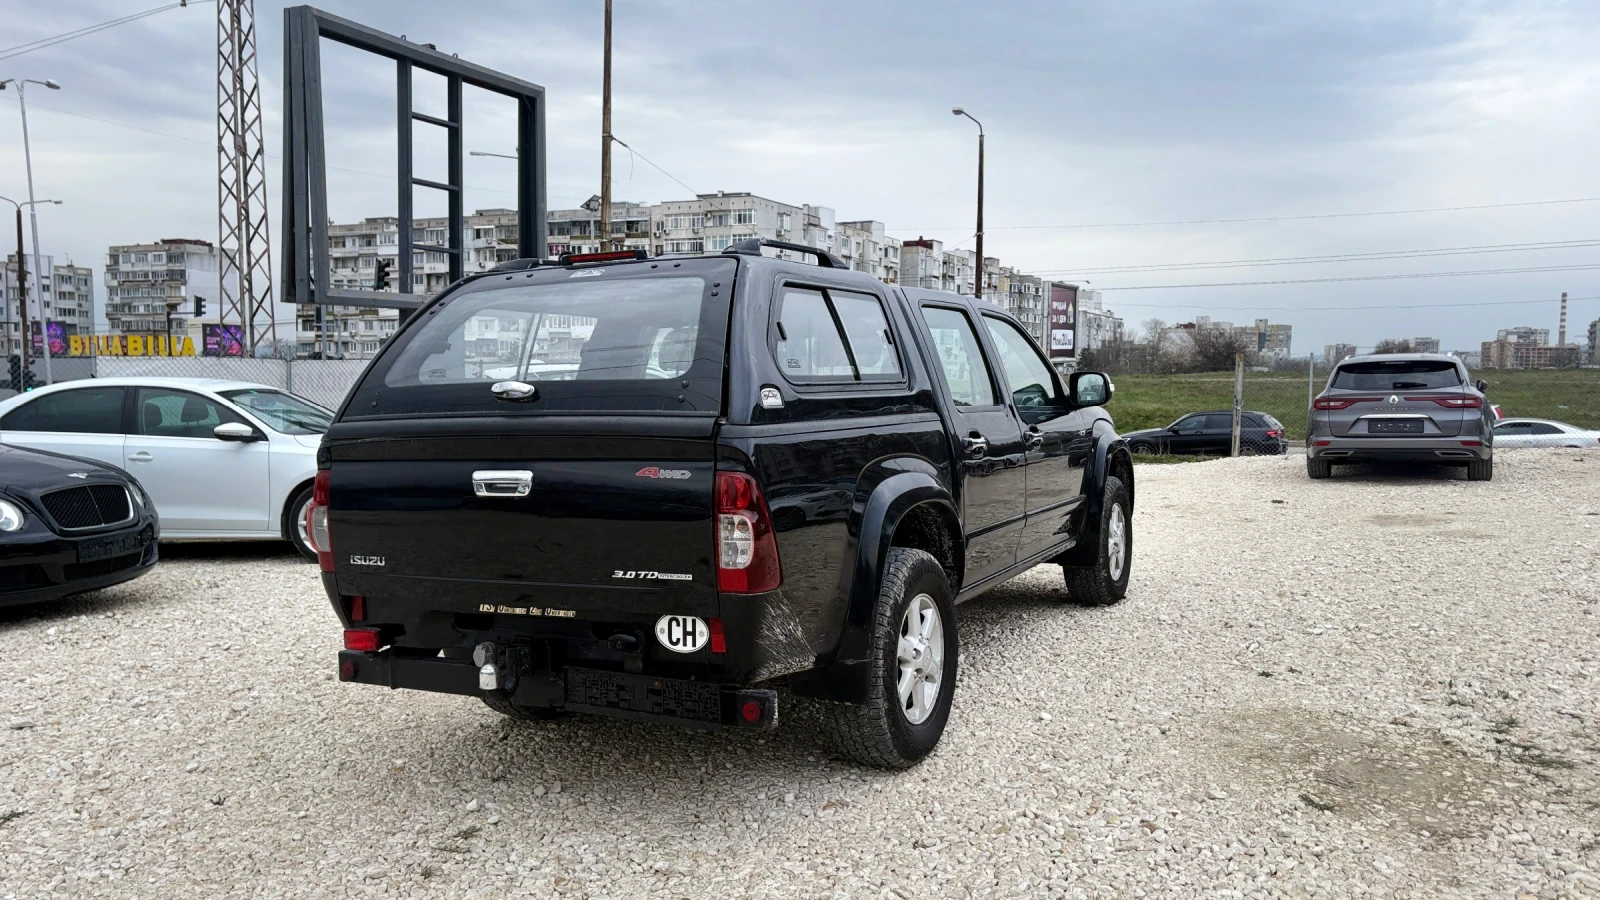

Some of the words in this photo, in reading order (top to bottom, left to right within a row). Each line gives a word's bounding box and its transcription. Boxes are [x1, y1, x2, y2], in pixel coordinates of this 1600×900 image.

[69, 335, 124, 357] BILLA
[127, 335, 196, 357] BILLA
[635, 466, 692, 480] 4WD
[350, 555, 386, 567] ISUZU
[667, 616, 697, 648] CH
